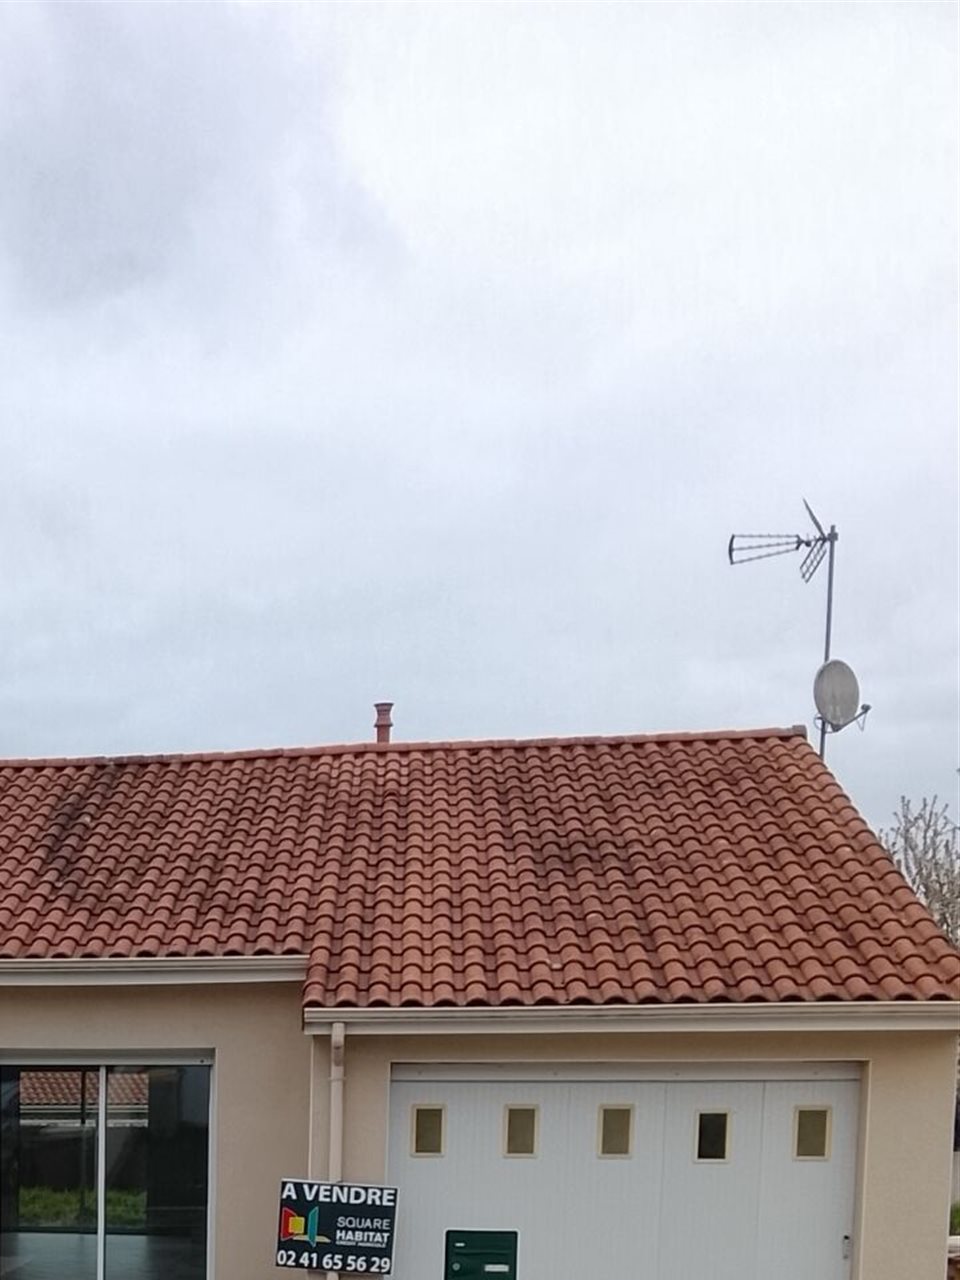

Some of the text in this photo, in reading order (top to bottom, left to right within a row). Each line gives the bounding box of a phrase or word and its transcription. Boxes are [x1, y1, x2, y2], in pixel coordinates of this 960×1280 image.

[282, 1183, 395, 1206] A VENDRE
[337, 1216, 391, 1230] SQUARE
[336, 1230, 390, 1244] HABITAT
[277, 1250, 391, 1273] 02 41 65 56 29
